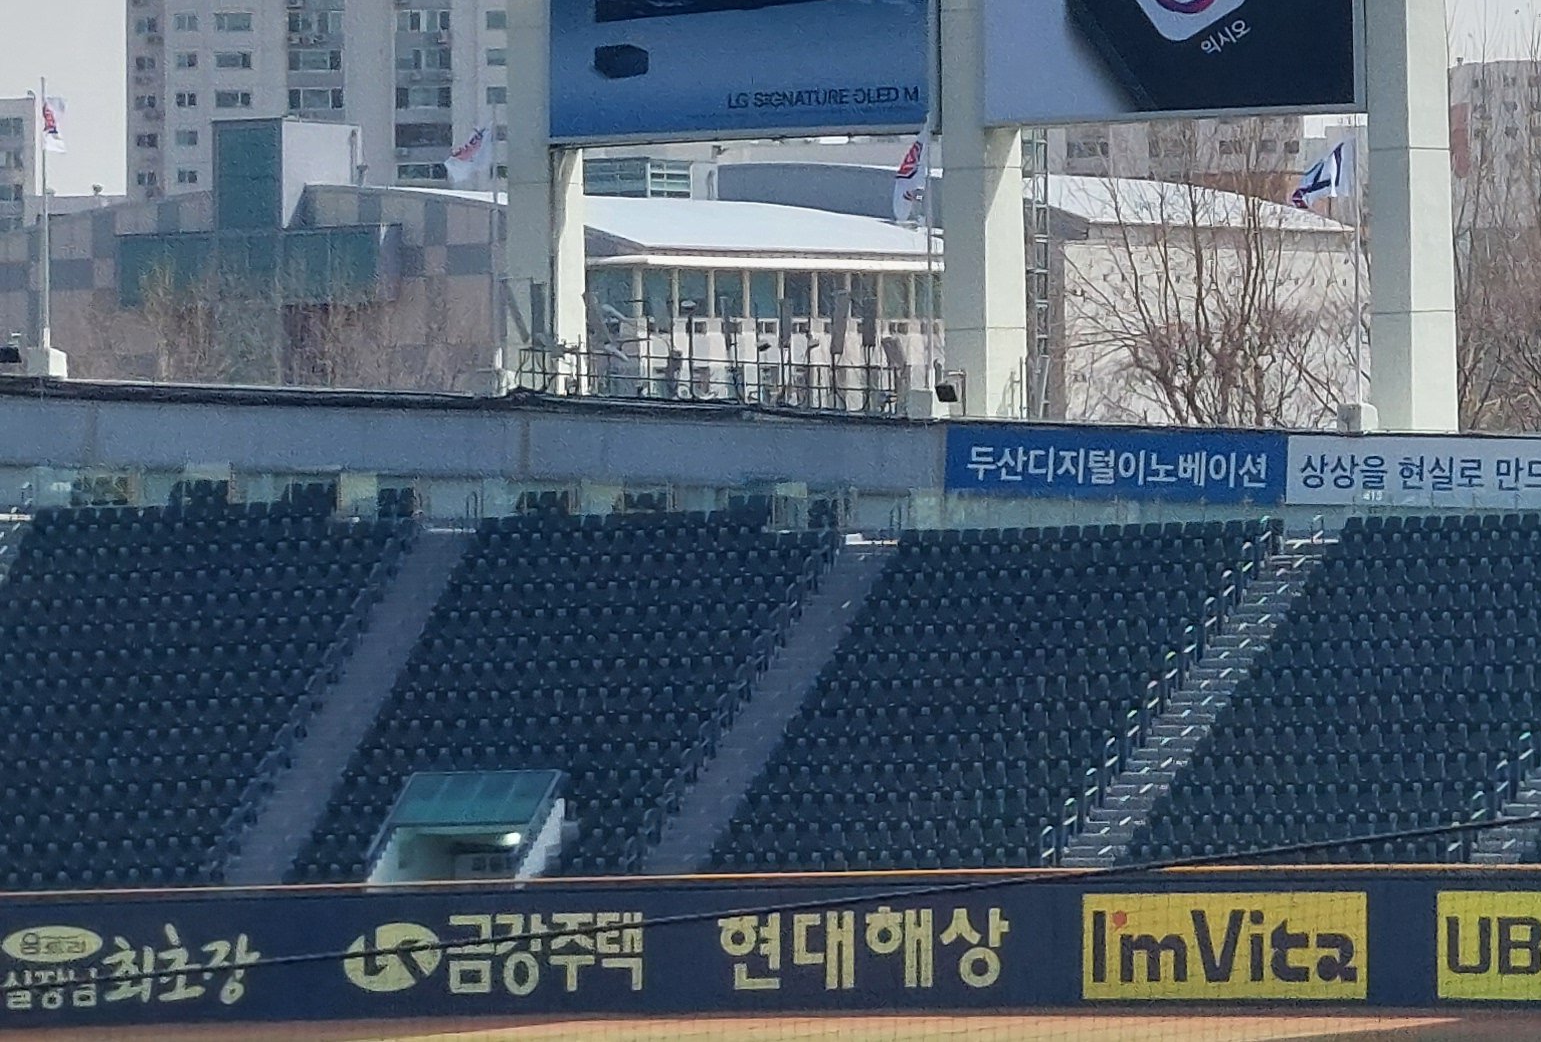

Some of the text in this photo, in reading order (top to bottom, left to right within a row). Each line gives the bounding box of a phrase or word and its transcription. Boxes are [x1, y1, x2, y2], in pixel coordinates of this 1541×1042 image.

[1200, 18, 1251, 56] 익시오
[727, 92, 749, 110] LG
[903, 88, 919, 103] M
[966, 446, 1267, 489] 두산디지털이노베이션
[1300, 454, 1388, 490] 상상을
[1398, 456, 1485, 498] 현실로
[449, 912, 643, 994] 금강주택
[718, 907, 1010, 991] 현대해상
